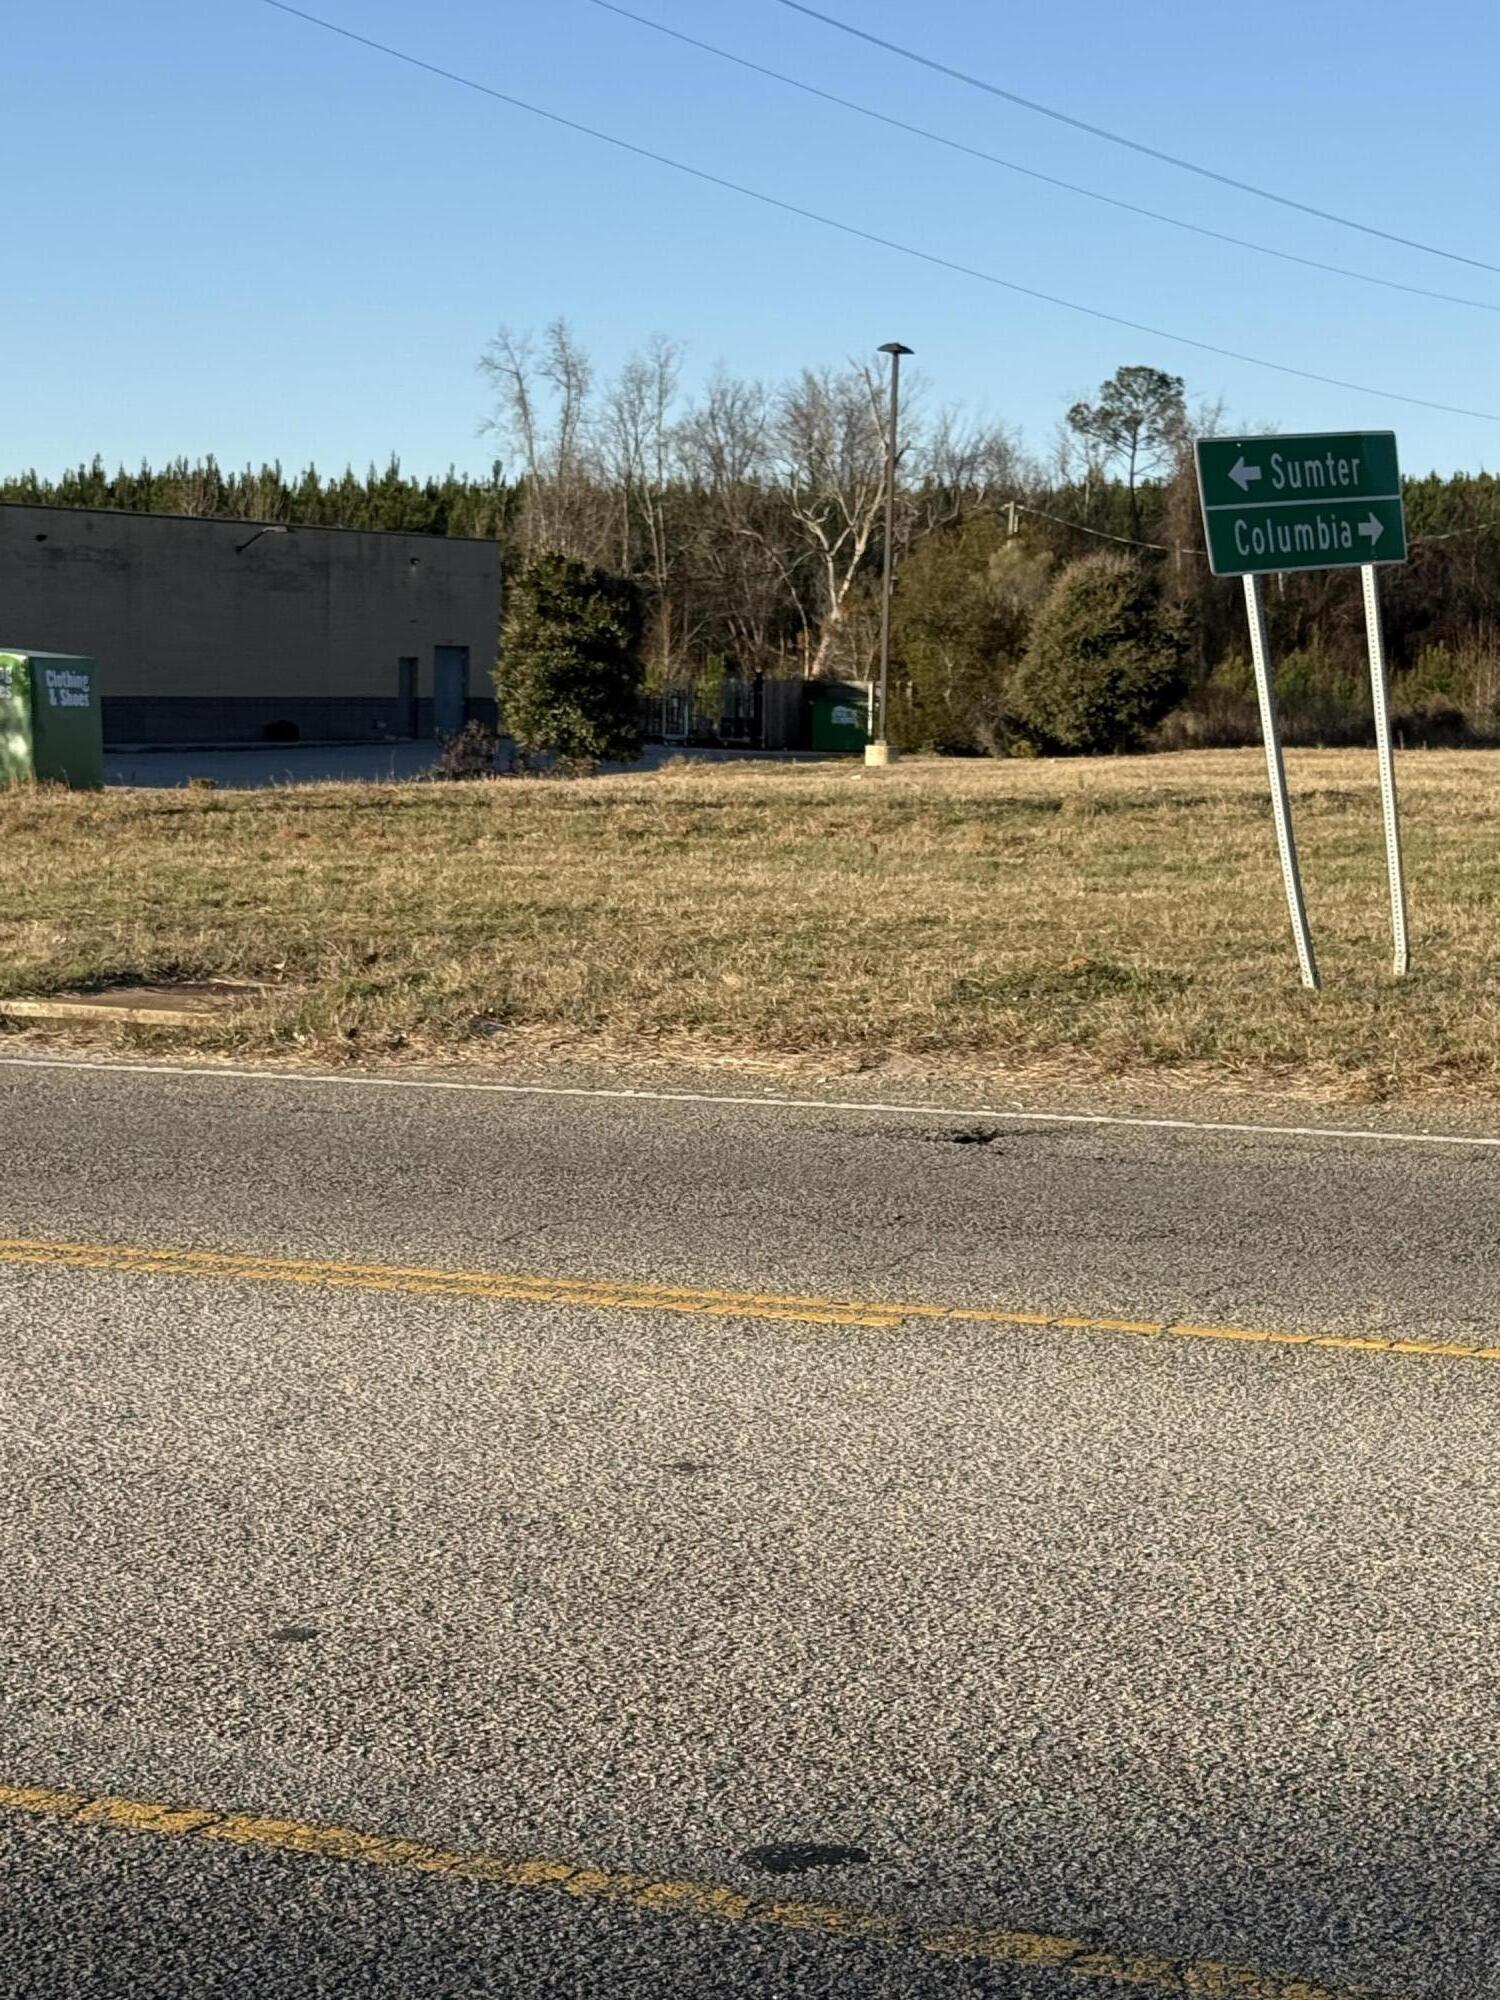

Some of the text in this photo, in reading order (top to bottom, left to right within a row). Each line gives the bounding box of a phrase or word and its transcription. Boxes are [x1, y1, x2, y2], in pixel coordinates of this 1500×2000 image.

[1270, 452, 1361, 490] Sumter
[1234, 514, 1353, 556] Columbia
[46, 669, 90, 692] Clothing
[60, 688, 90, 707] Shoes
